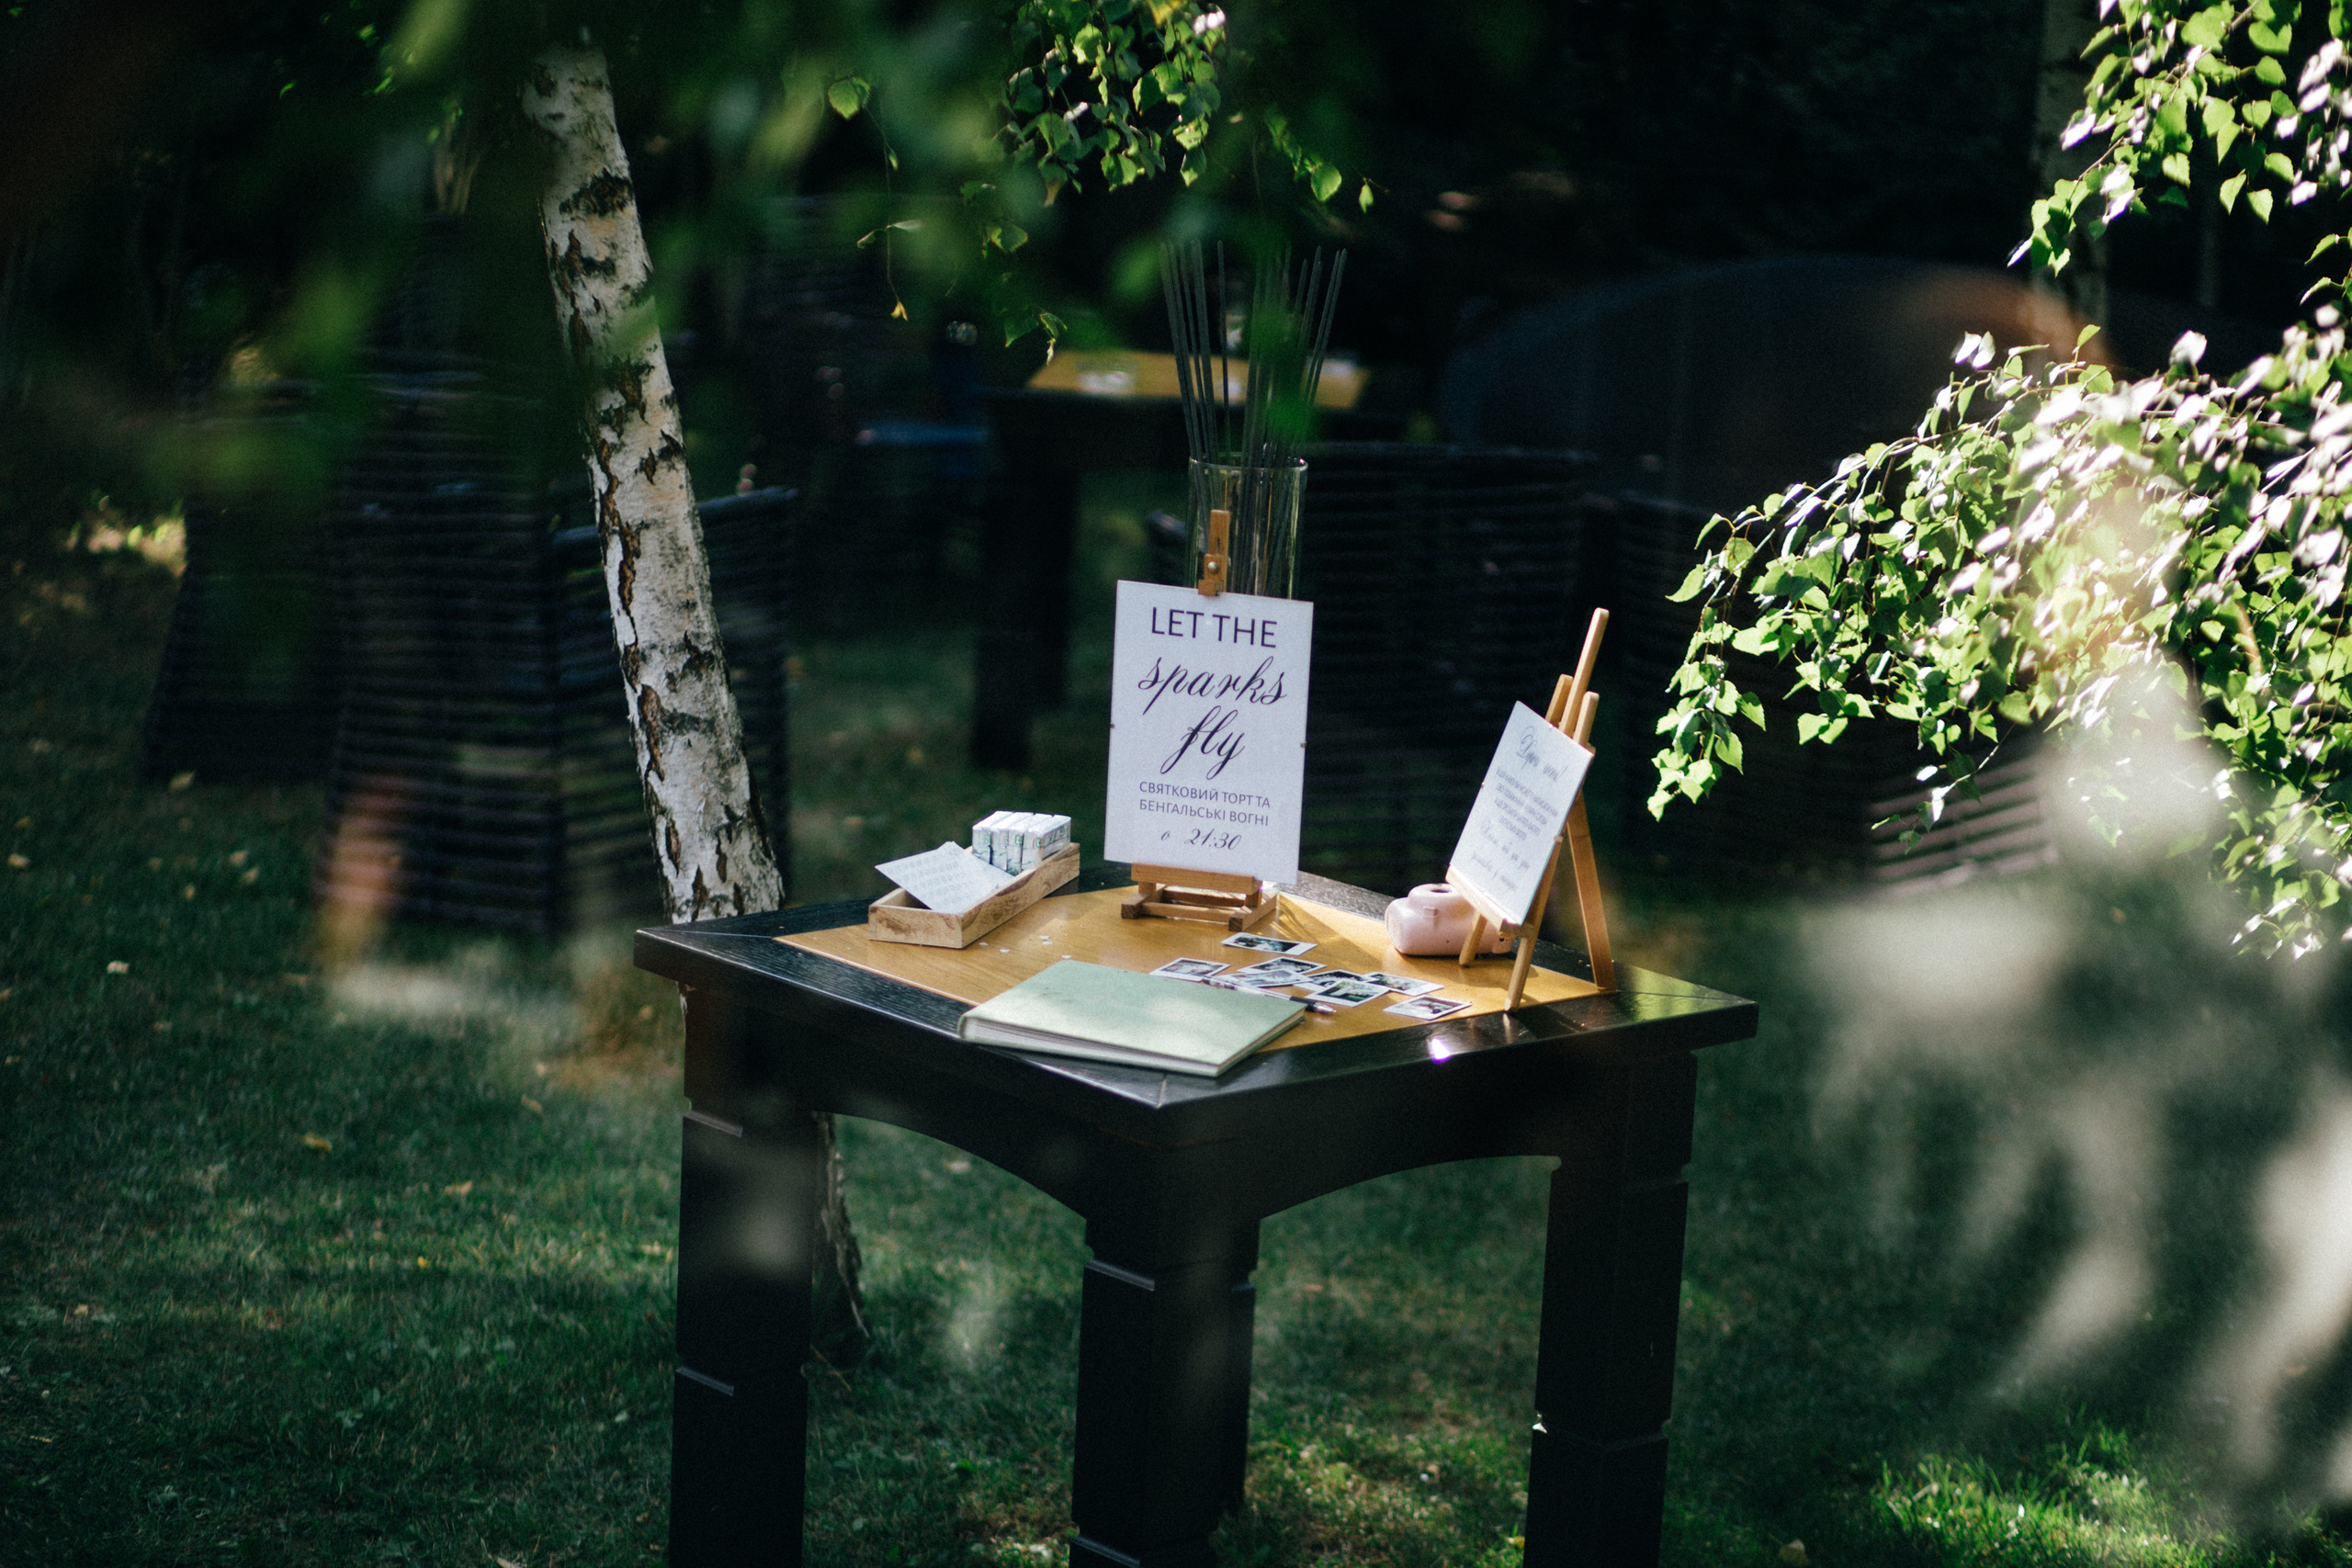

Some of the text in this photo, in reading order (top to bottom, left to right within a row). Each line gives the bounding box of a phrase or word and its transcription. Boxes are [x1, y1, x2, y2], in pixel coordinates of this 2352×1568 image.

[1151, 606, 1277, 649] LET THE
[1137, 656, 1287, 716] sparks
[1159, 705, 1246, 781] fly
[1139, 781, 1271, 808] СВЯТКОВИЙ ТОРТ ТА
[1139, 799, 1269, 826] БЕНГАЛЬСЬКІ ВОГНІ
[1184, 828, 1242, 850] 21:30
